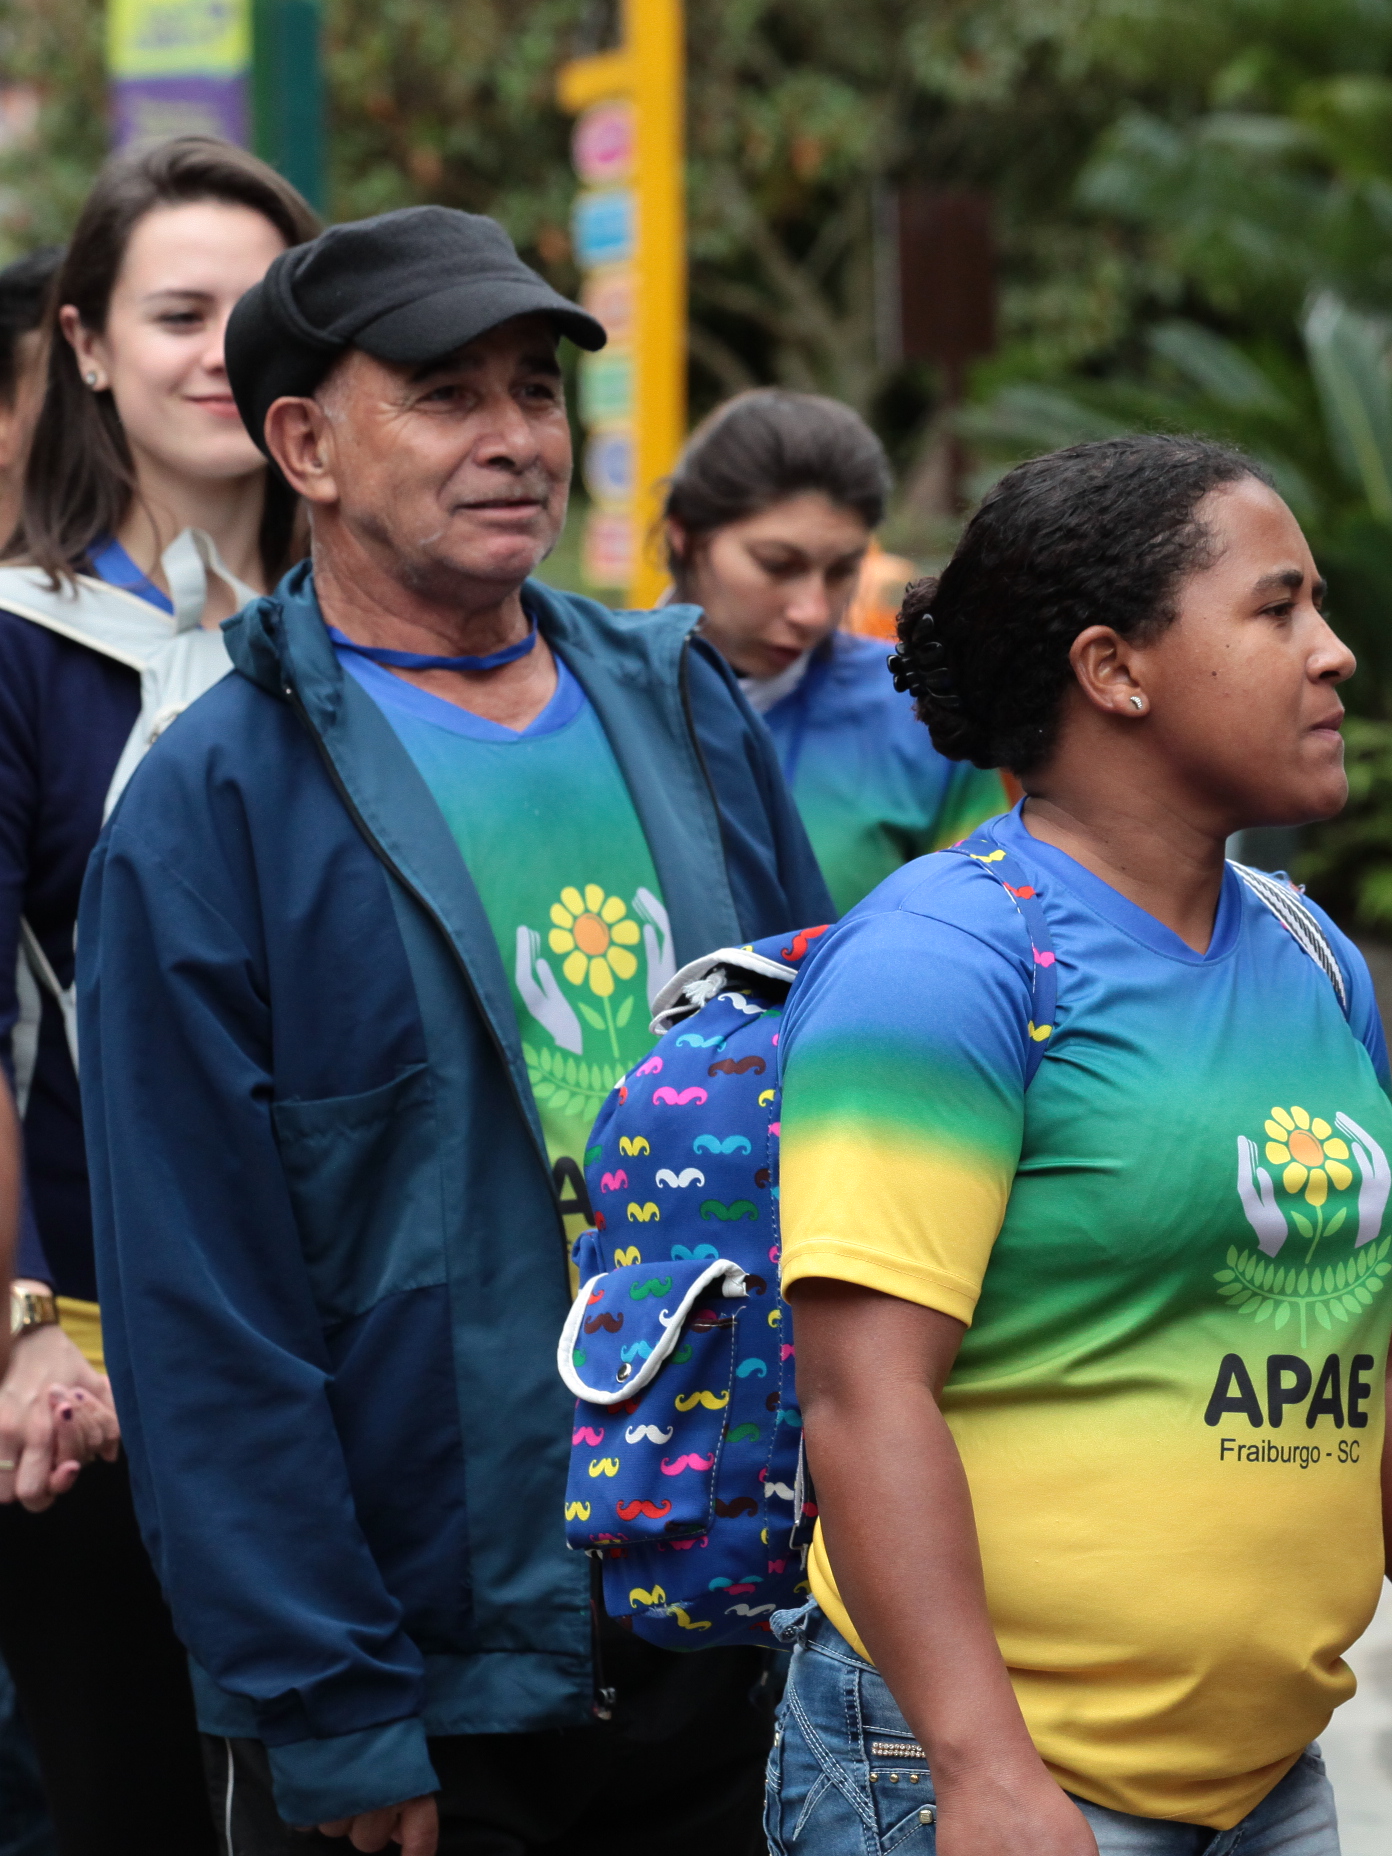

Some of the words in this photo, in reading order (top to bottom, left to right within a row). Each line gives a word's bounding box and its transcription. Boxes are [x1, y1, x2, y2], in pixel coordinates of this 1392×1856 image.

[1203, 1352, 1375, 1430] APAE
[1219, 1437, 1321, 1470] Fraiburgo
[1337, 1439, 1361, 1464] SC
